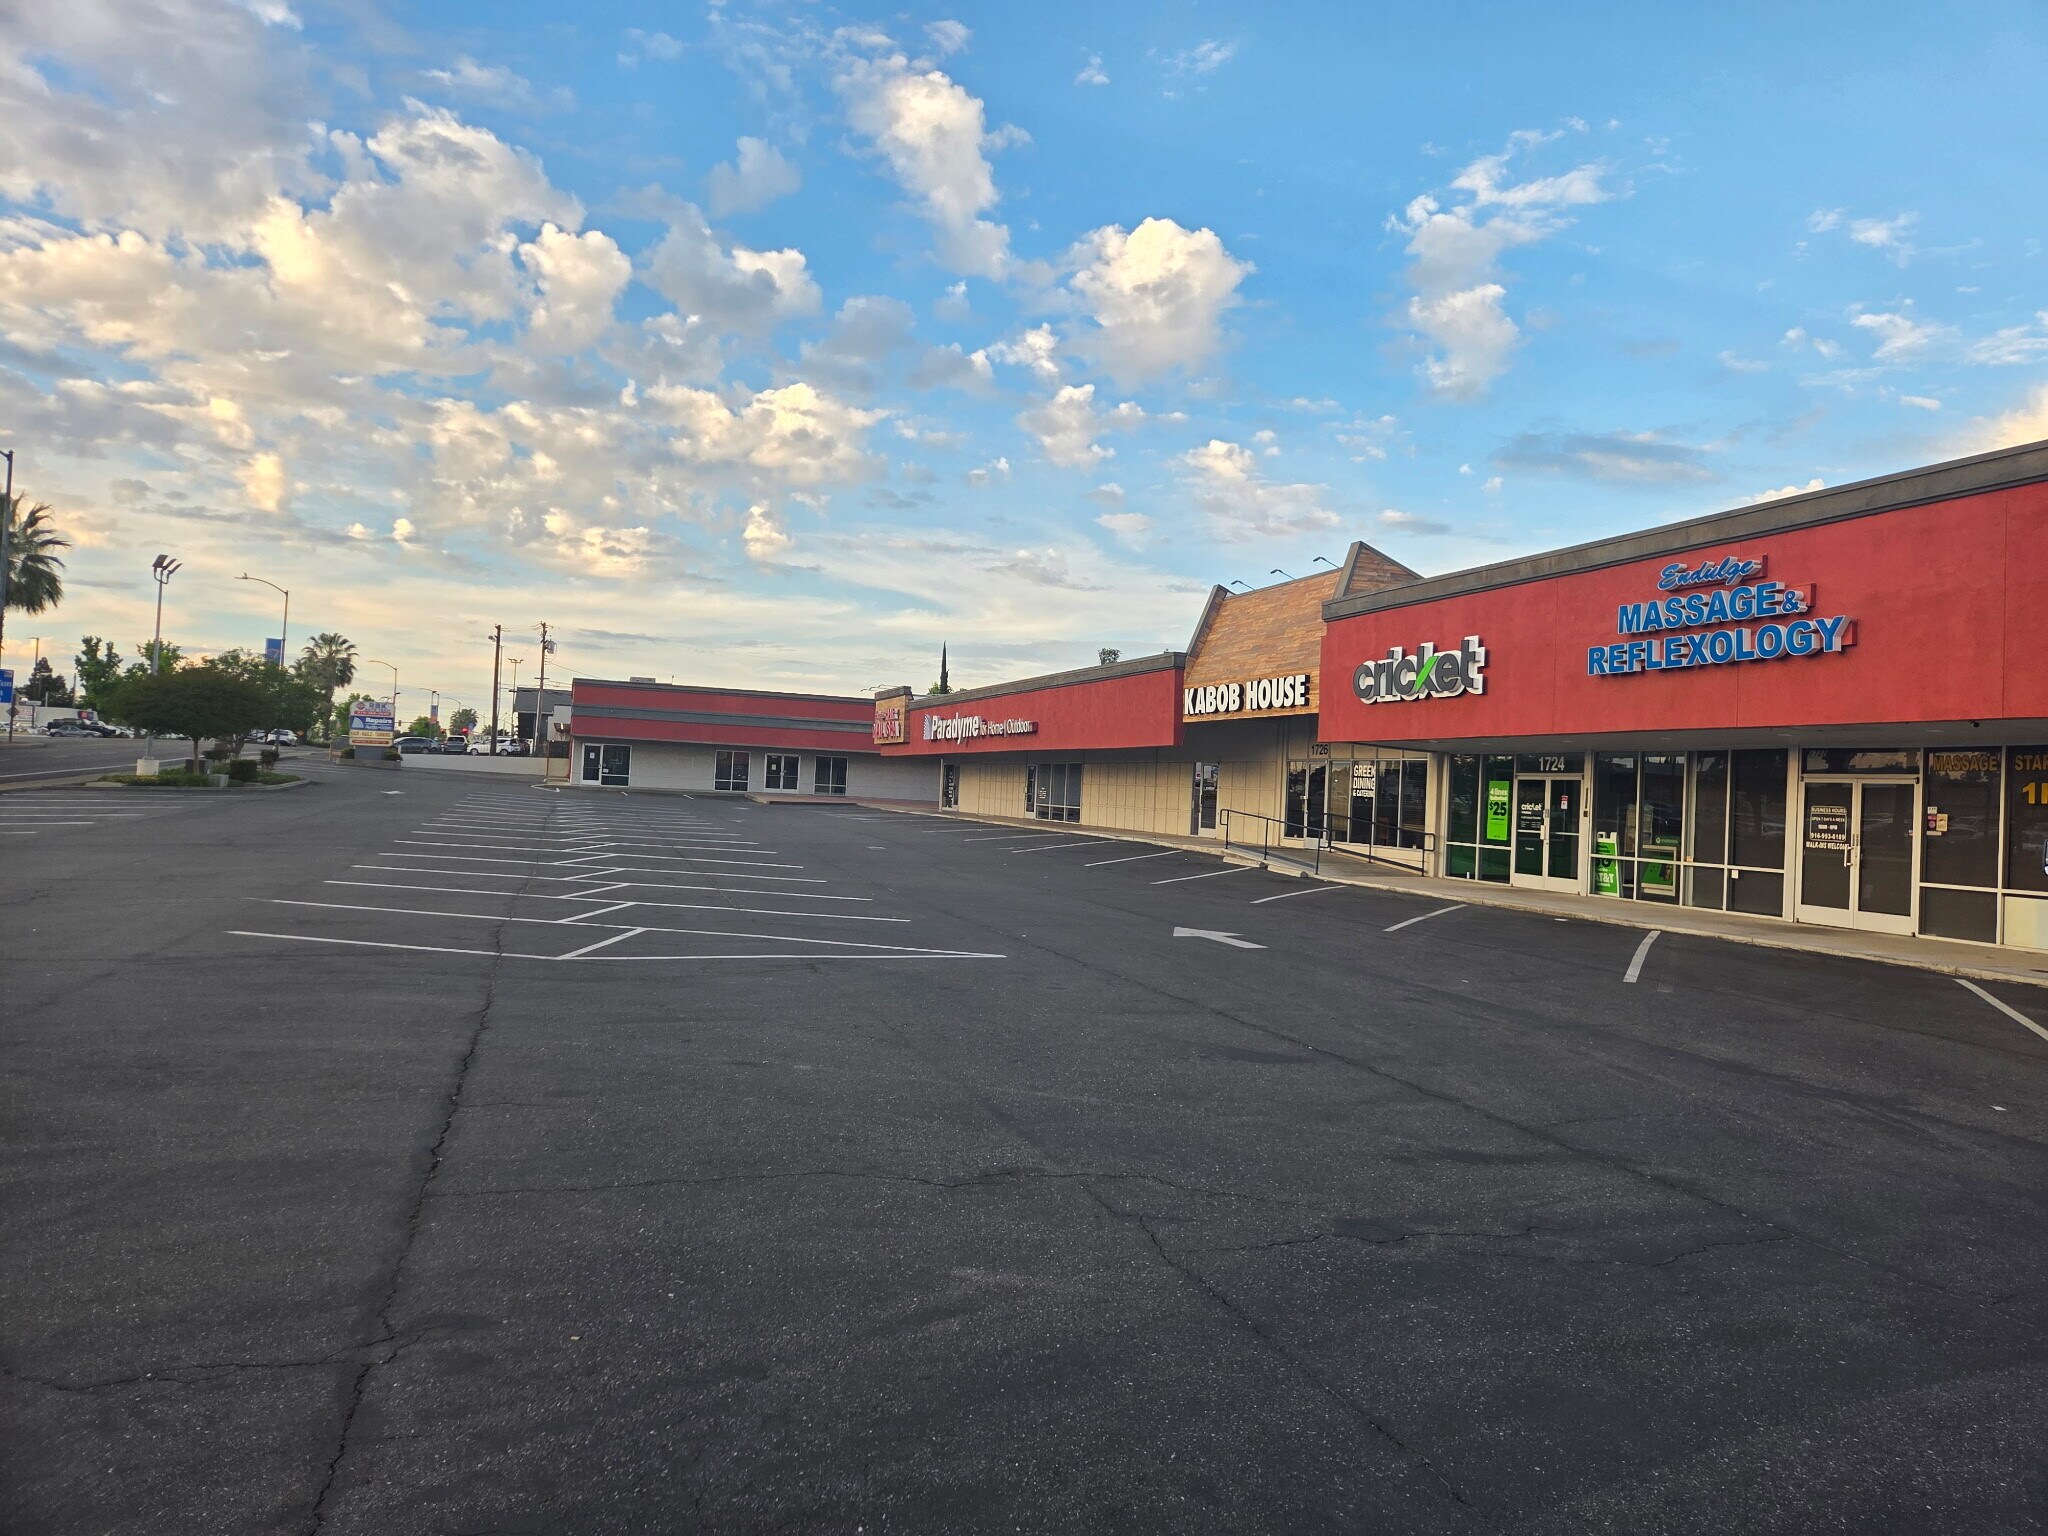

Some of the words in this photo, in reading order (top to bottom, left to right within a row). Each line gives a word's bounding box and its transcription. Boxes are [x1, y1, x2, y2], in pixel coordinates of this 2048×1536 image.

[1657, 555, 1755, 591] Endulge
[1617, 581, 1781, 635] MASSAGE
[1782, 590, 1805, 614] &
[1587, 614, 1847, 677] REFLEXOLOGY
[1353, 638, 1480, 702] cricket
[1183, 682, 1242, 715] KABOB
[1245, 674, 1307, 710] HOUSE
[930, 712, 980, 745] Paradyme
[987, 720, 1004, 736] Home
[1006, 717, 1031, 734] Outdoor
[1311, 744, 1329, 756] 1726
[1932, 754, 1998, 771] MASSAGE
[1353, 764, 1376, 778] GREEK
[1538, 756, 1565, 772] 1724
[1353, 777, 1375, 790] DINING
[1488, 801, 1507, 817] $25
